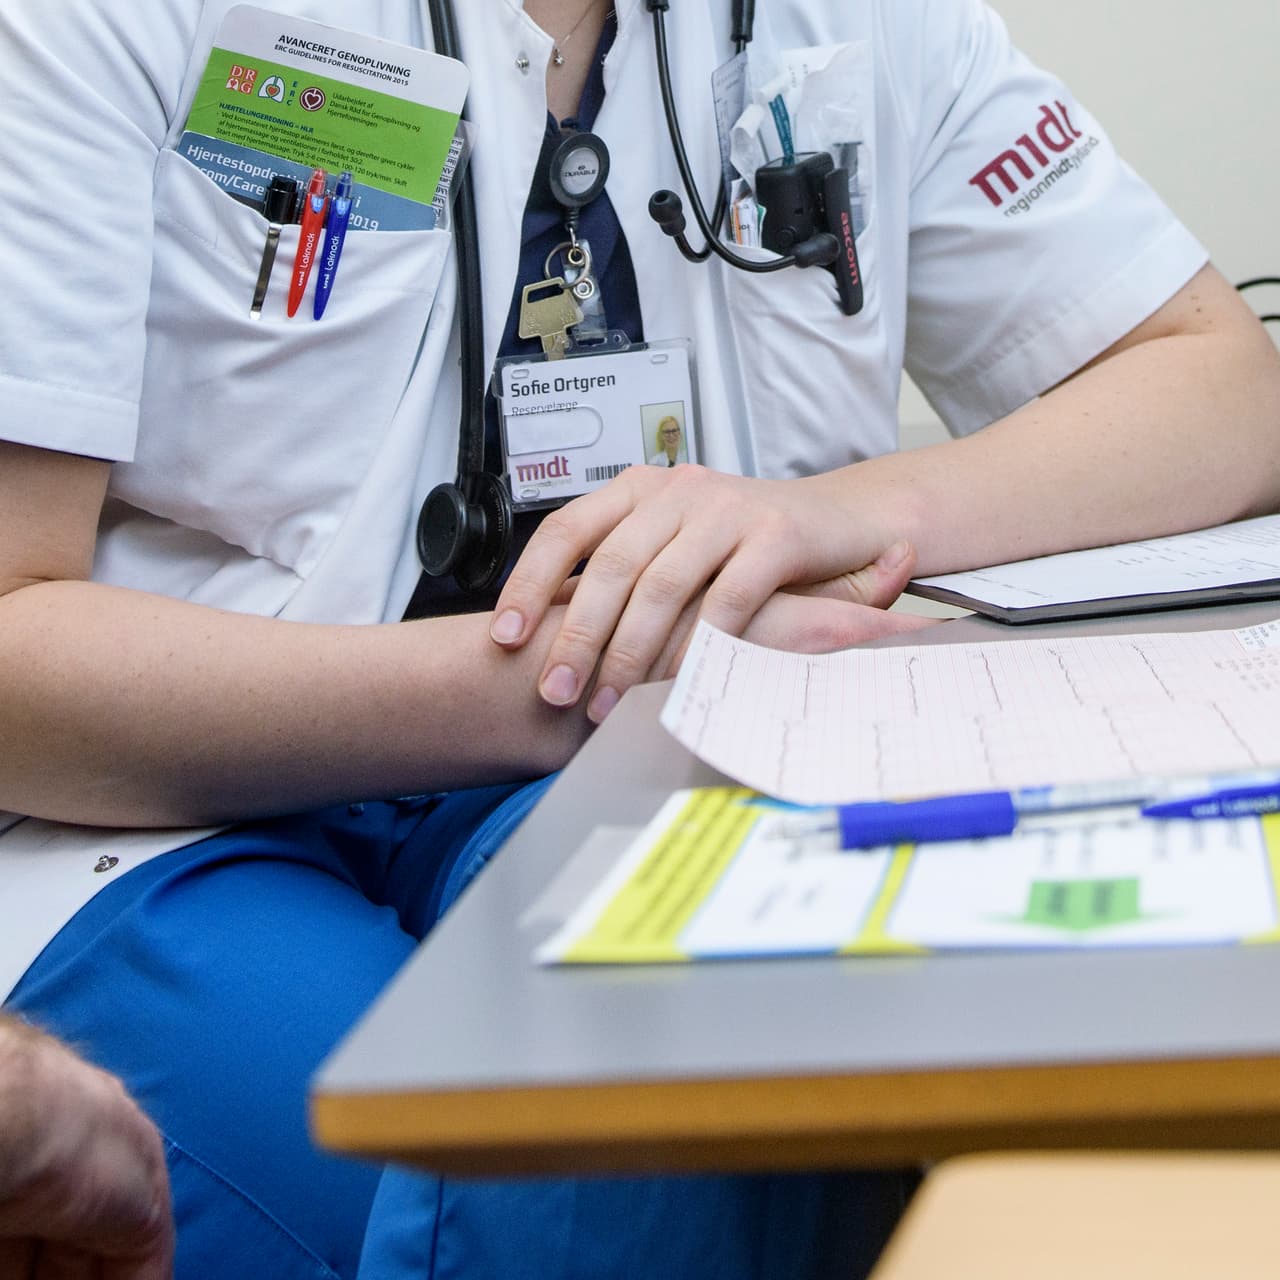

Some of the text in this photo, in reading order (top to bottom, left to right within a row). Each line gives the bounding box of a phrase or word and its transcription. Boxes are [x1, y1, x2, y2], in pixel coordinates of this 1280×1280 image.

[274, 44, 409, 86] ERC GUIDELINES FOR RESUSCITATION 2015
[278, 34, 411, 78] AVANCERET GENOPLIVNING
[968, 99, 1083, 208] midt
[841, 210, 859, 286] ascom
[511, 374, 617, 398] Sofie Ortgren
[515, 455, 572, 483] midt
